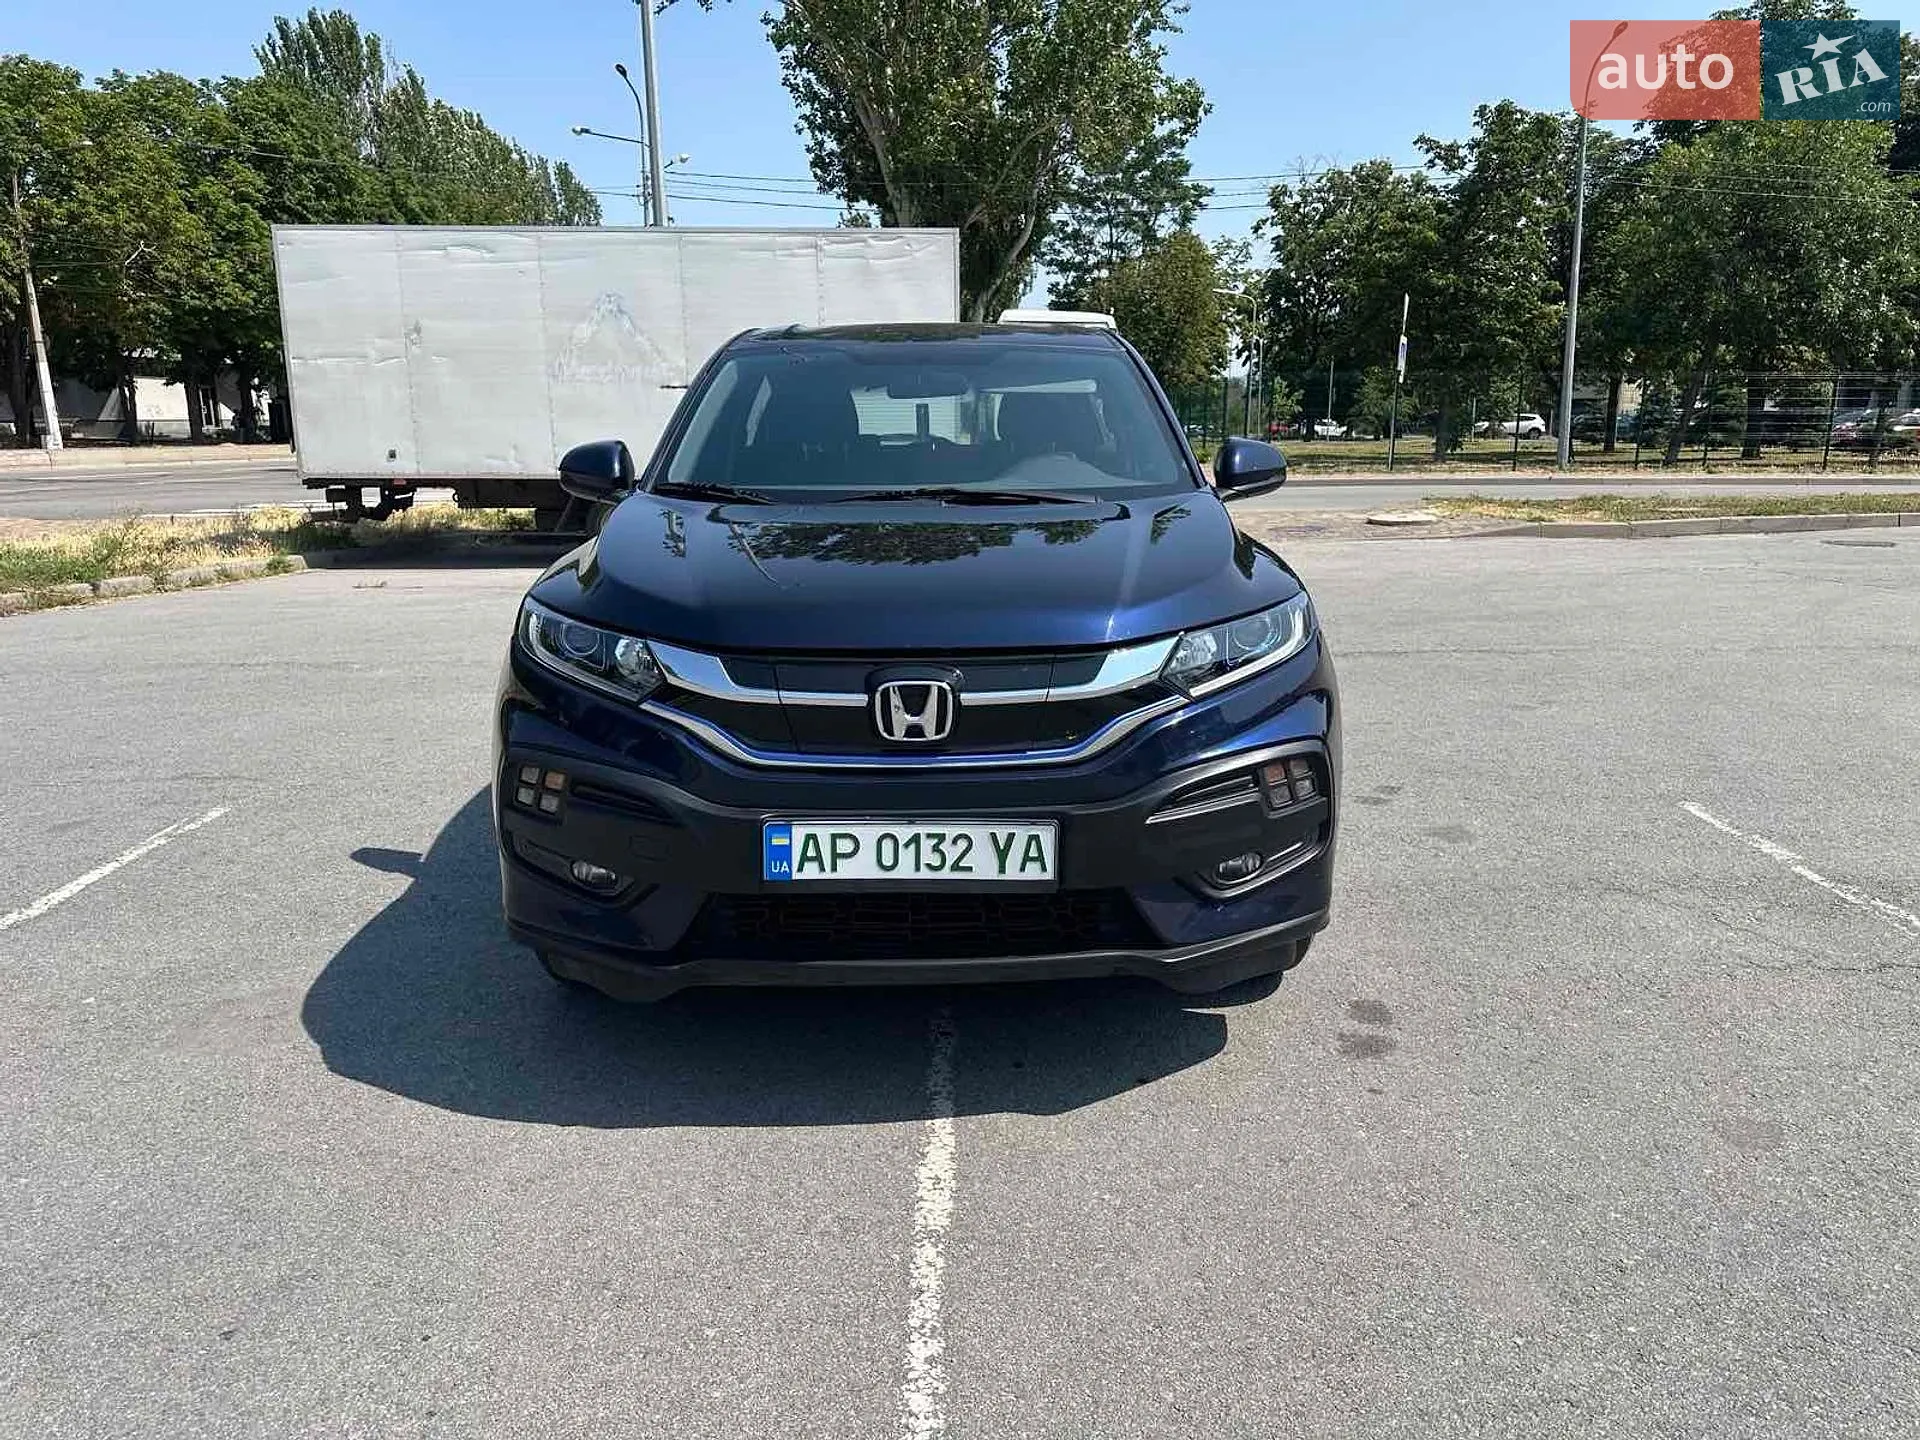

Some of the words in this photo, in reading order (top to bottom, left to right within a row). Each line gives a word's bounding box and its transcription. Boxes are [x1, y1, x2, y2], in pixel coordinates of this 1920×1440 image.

[771, 860, 790, 873] UA
[797, 833, 861, 873] AP
[876, 832, 974, 873] 0132
[990, 832, 1048, 874] YA
